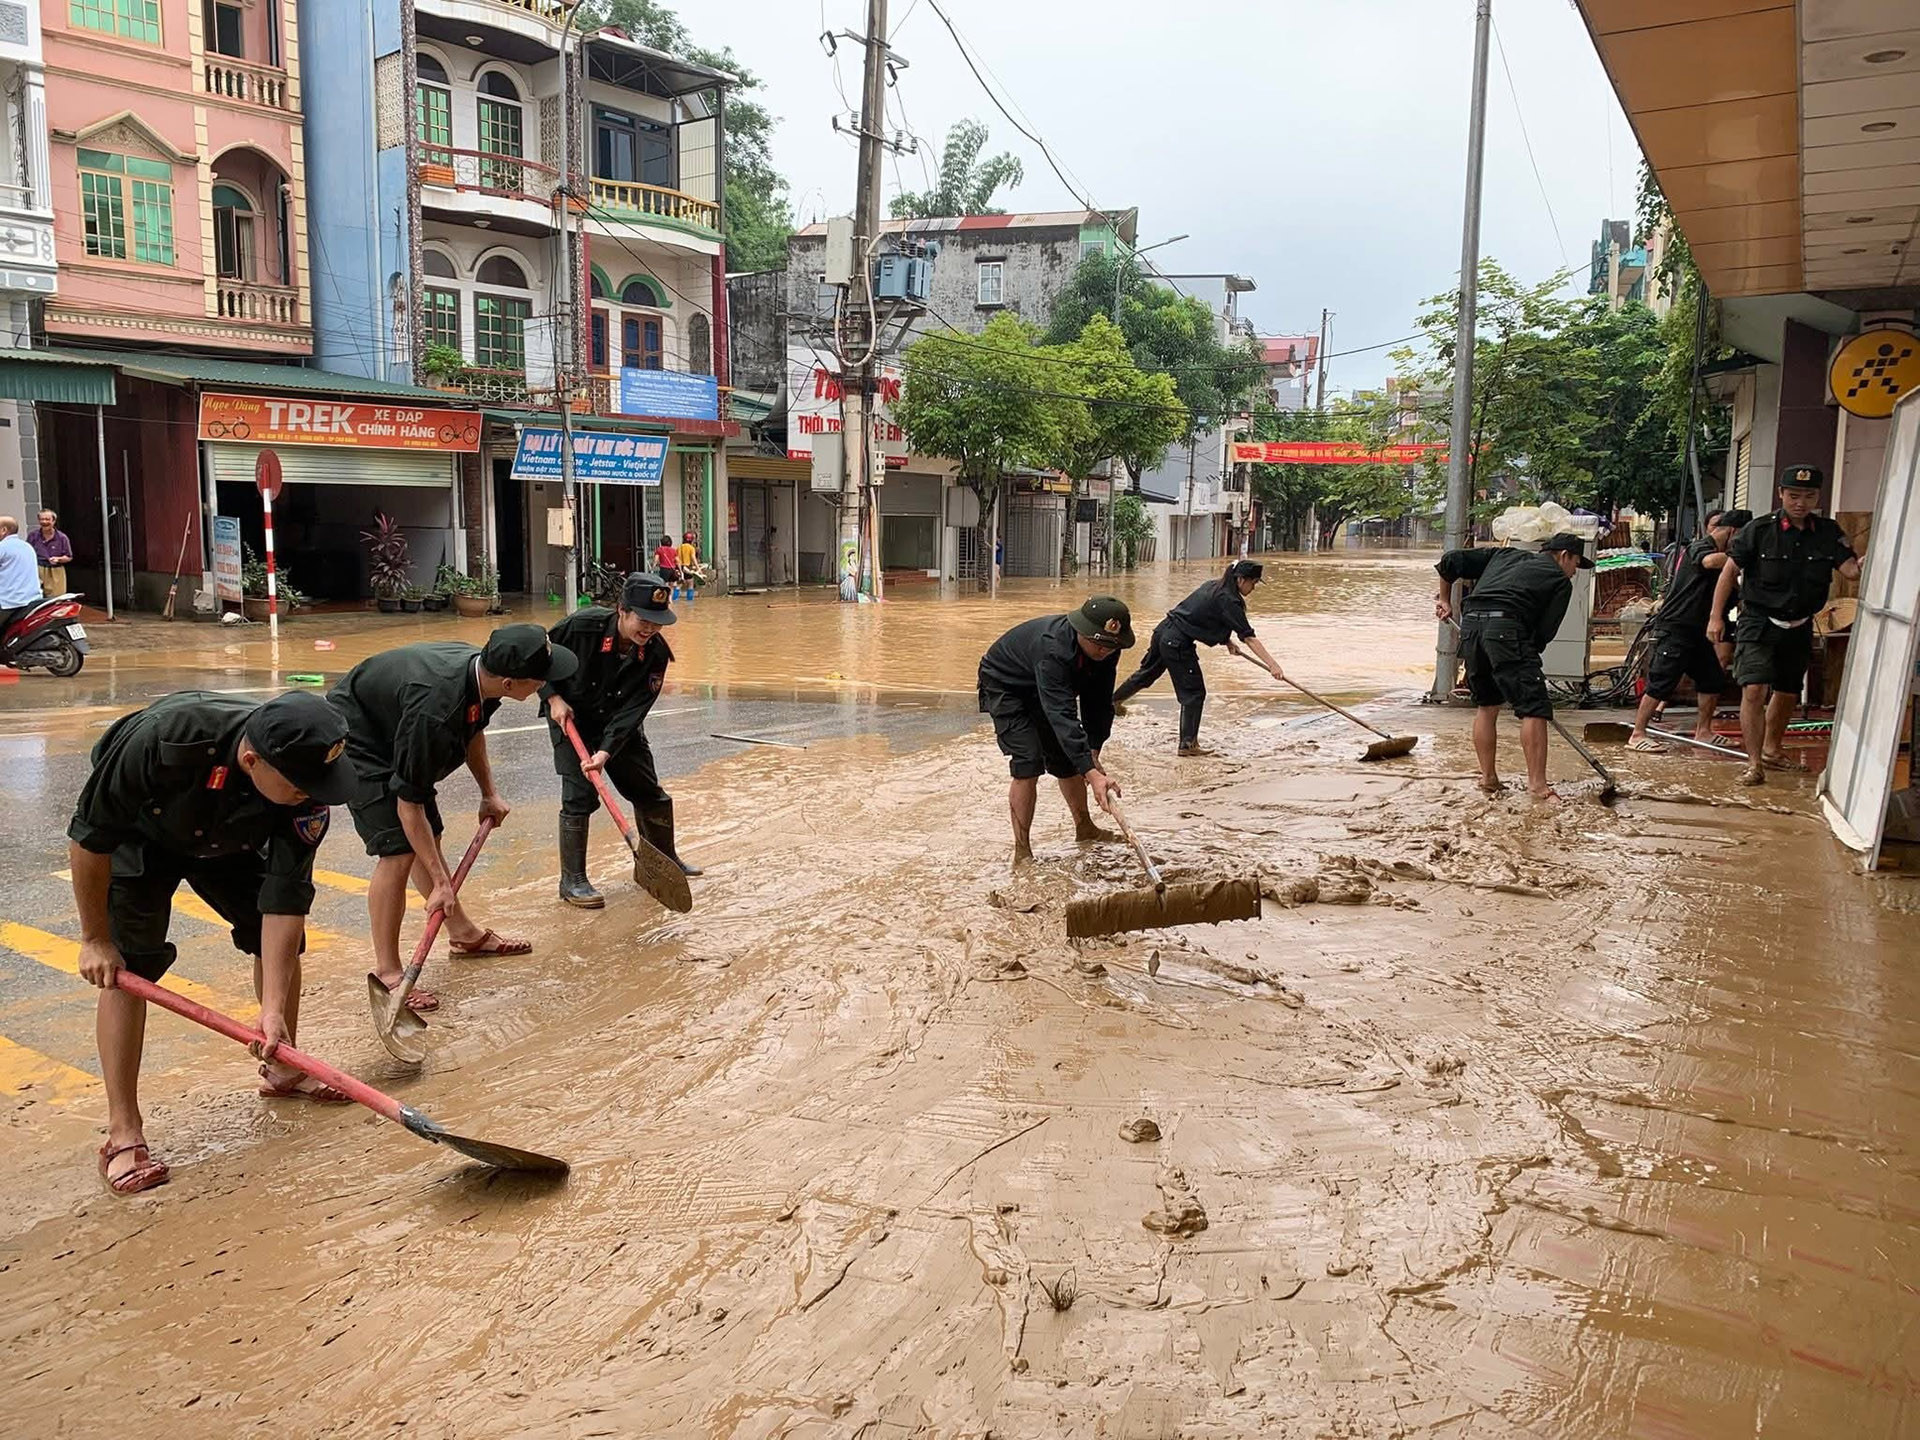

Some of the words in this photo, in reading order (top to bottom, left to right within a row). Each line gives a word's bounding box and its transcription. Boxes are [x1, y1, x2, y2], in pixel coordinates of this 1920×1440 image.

[265, 401, 355, 434] TREK
[374, 408, 391, 421] XE
[396, 410, 423, 425] ĐẠP
[357, 421, 396, 436] CHÍNH
[400, 423, 436, 438] HÀNG
[522, 453, 556, 465] Vietnam
[589, 458, 617, 468] Jetstar
